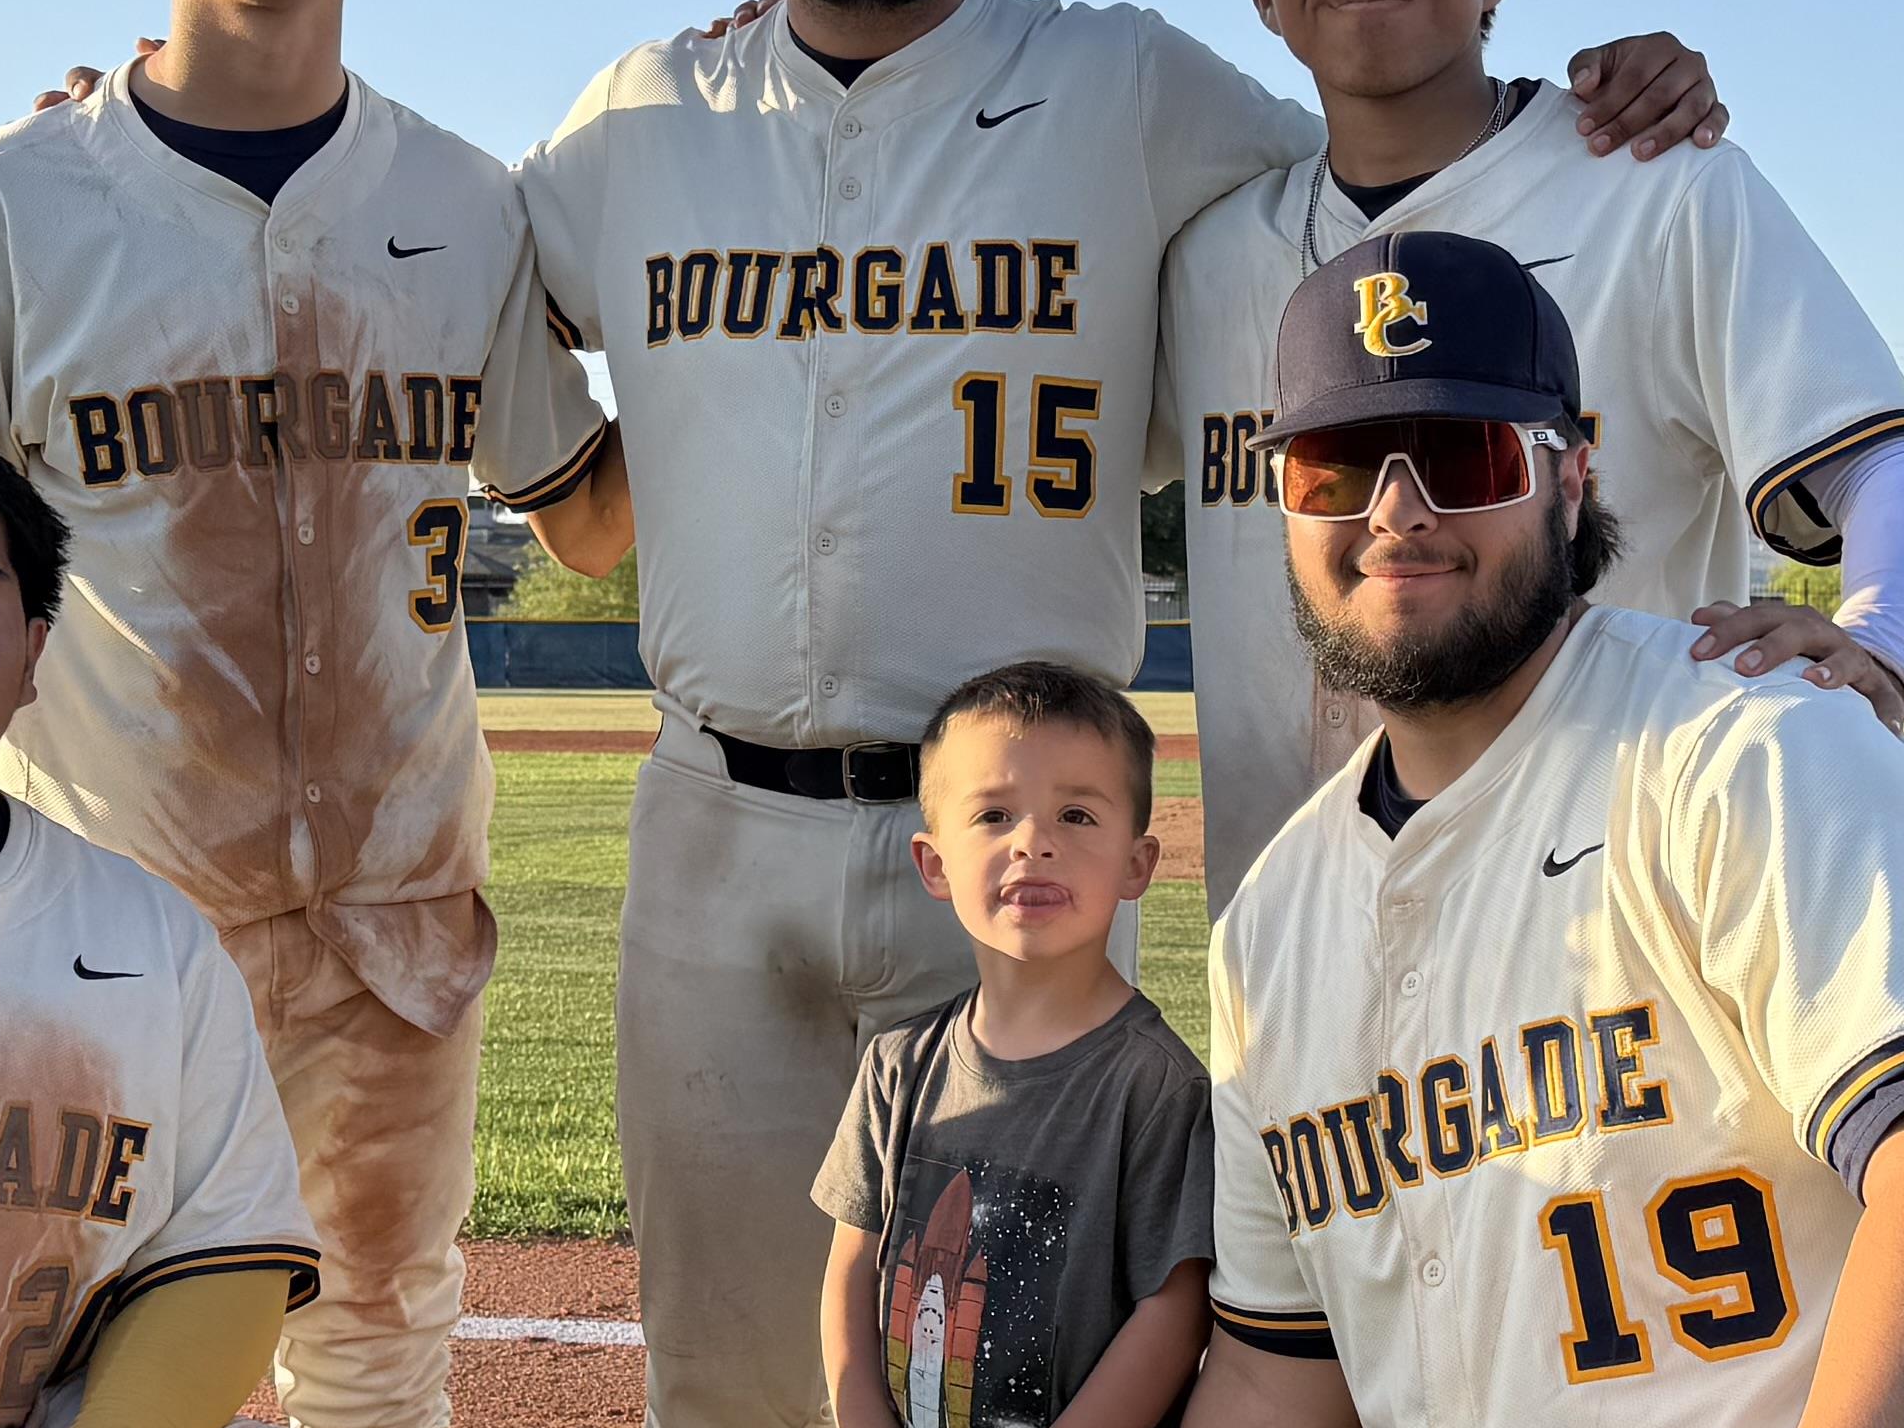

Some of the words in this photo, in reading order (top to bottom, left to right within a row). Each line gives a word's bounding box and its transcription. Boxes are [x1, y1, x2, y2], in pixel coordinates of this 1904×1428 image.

[646, 238, 1080, 349] BOURGADE
[69, 369, 482, 488] BOURGADE
[952, 371, 1102, 518] 15
[407, 497, 468, 634] 3
[1261, 1000, 1676, 1239] BOURGADE
[1537, 1166, 1799, 1385] 19
